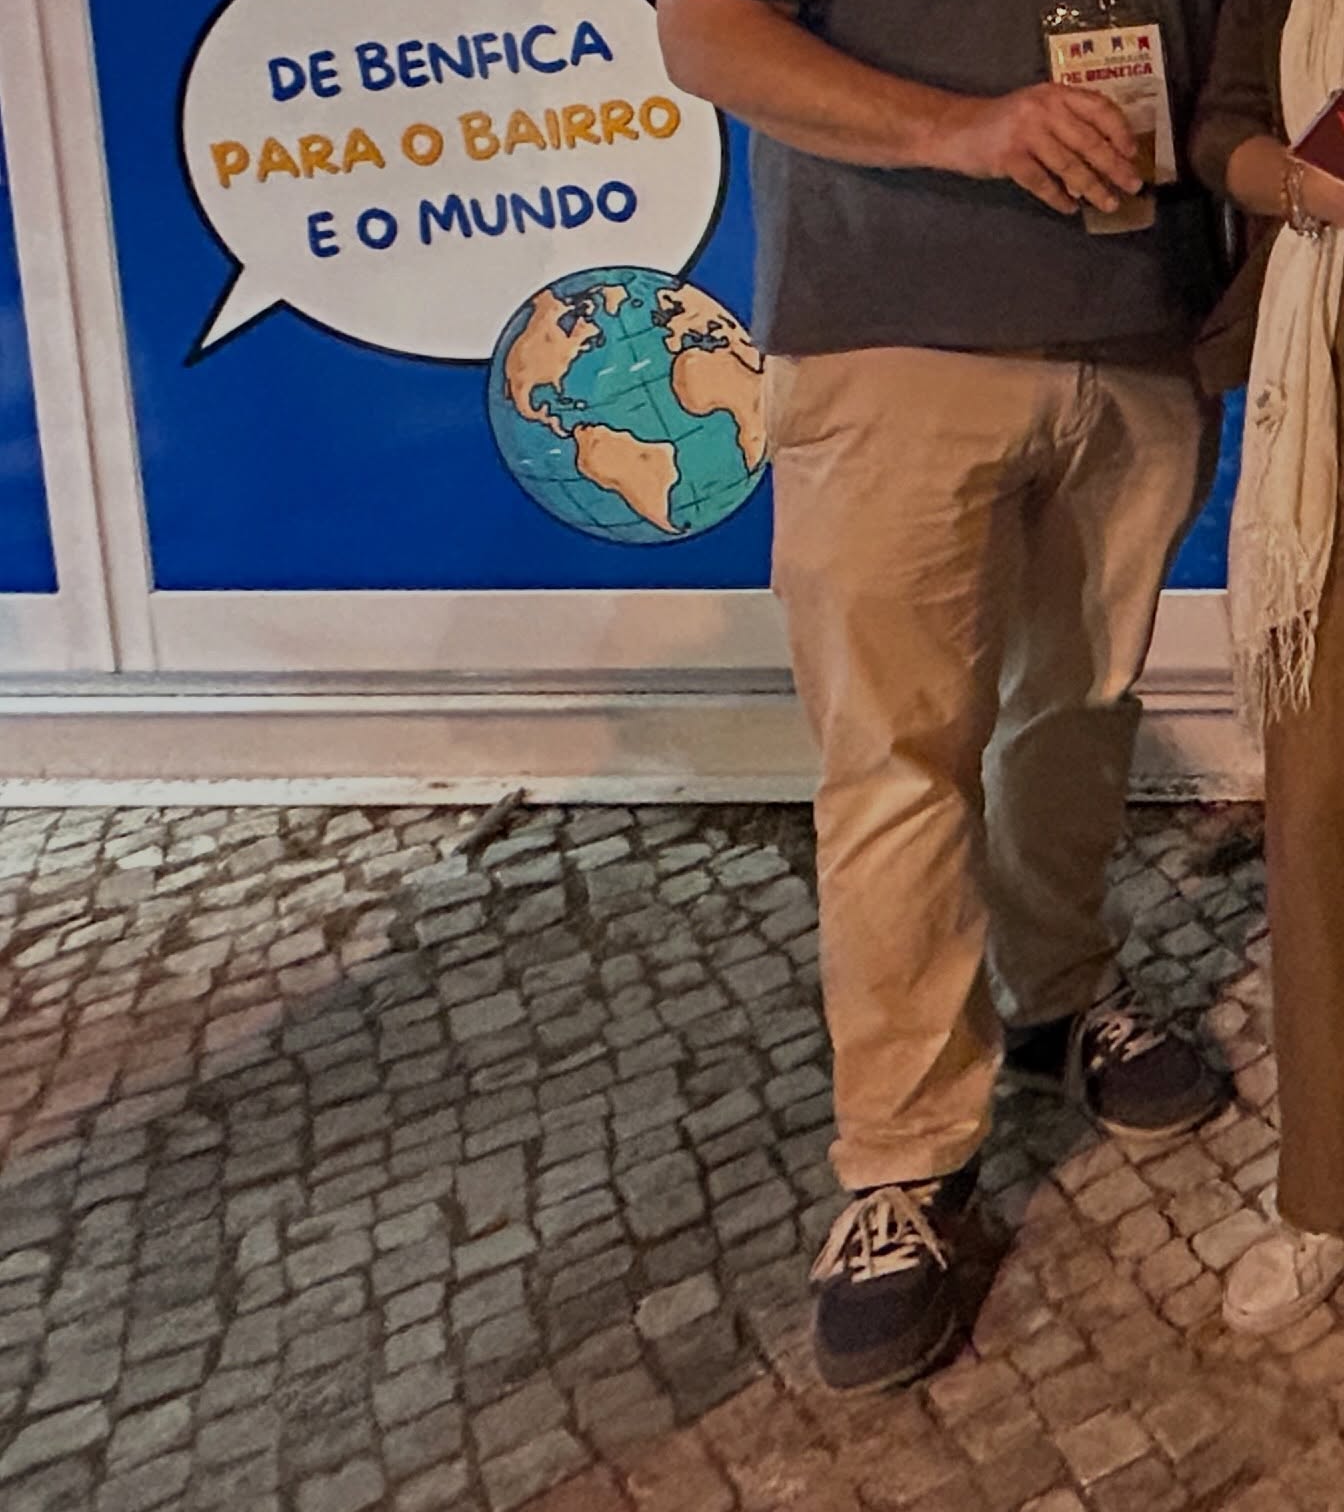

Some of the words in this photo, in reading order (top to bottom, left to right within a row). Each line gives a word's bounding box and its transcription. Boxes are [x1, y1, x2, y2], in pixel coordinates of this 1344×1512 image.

[267, 50, 342, 102] DE
[354, 20, 614, 92] BENFICA
[210, 127, 386, 187] PARA
[399, 122, 445, 167] O
[459, 94, 682, 163] BAIRRO
[307, 210, 341, 258] E
[356, 207, 398, 250] O
[419, 180, 638, 246] MUNDO
